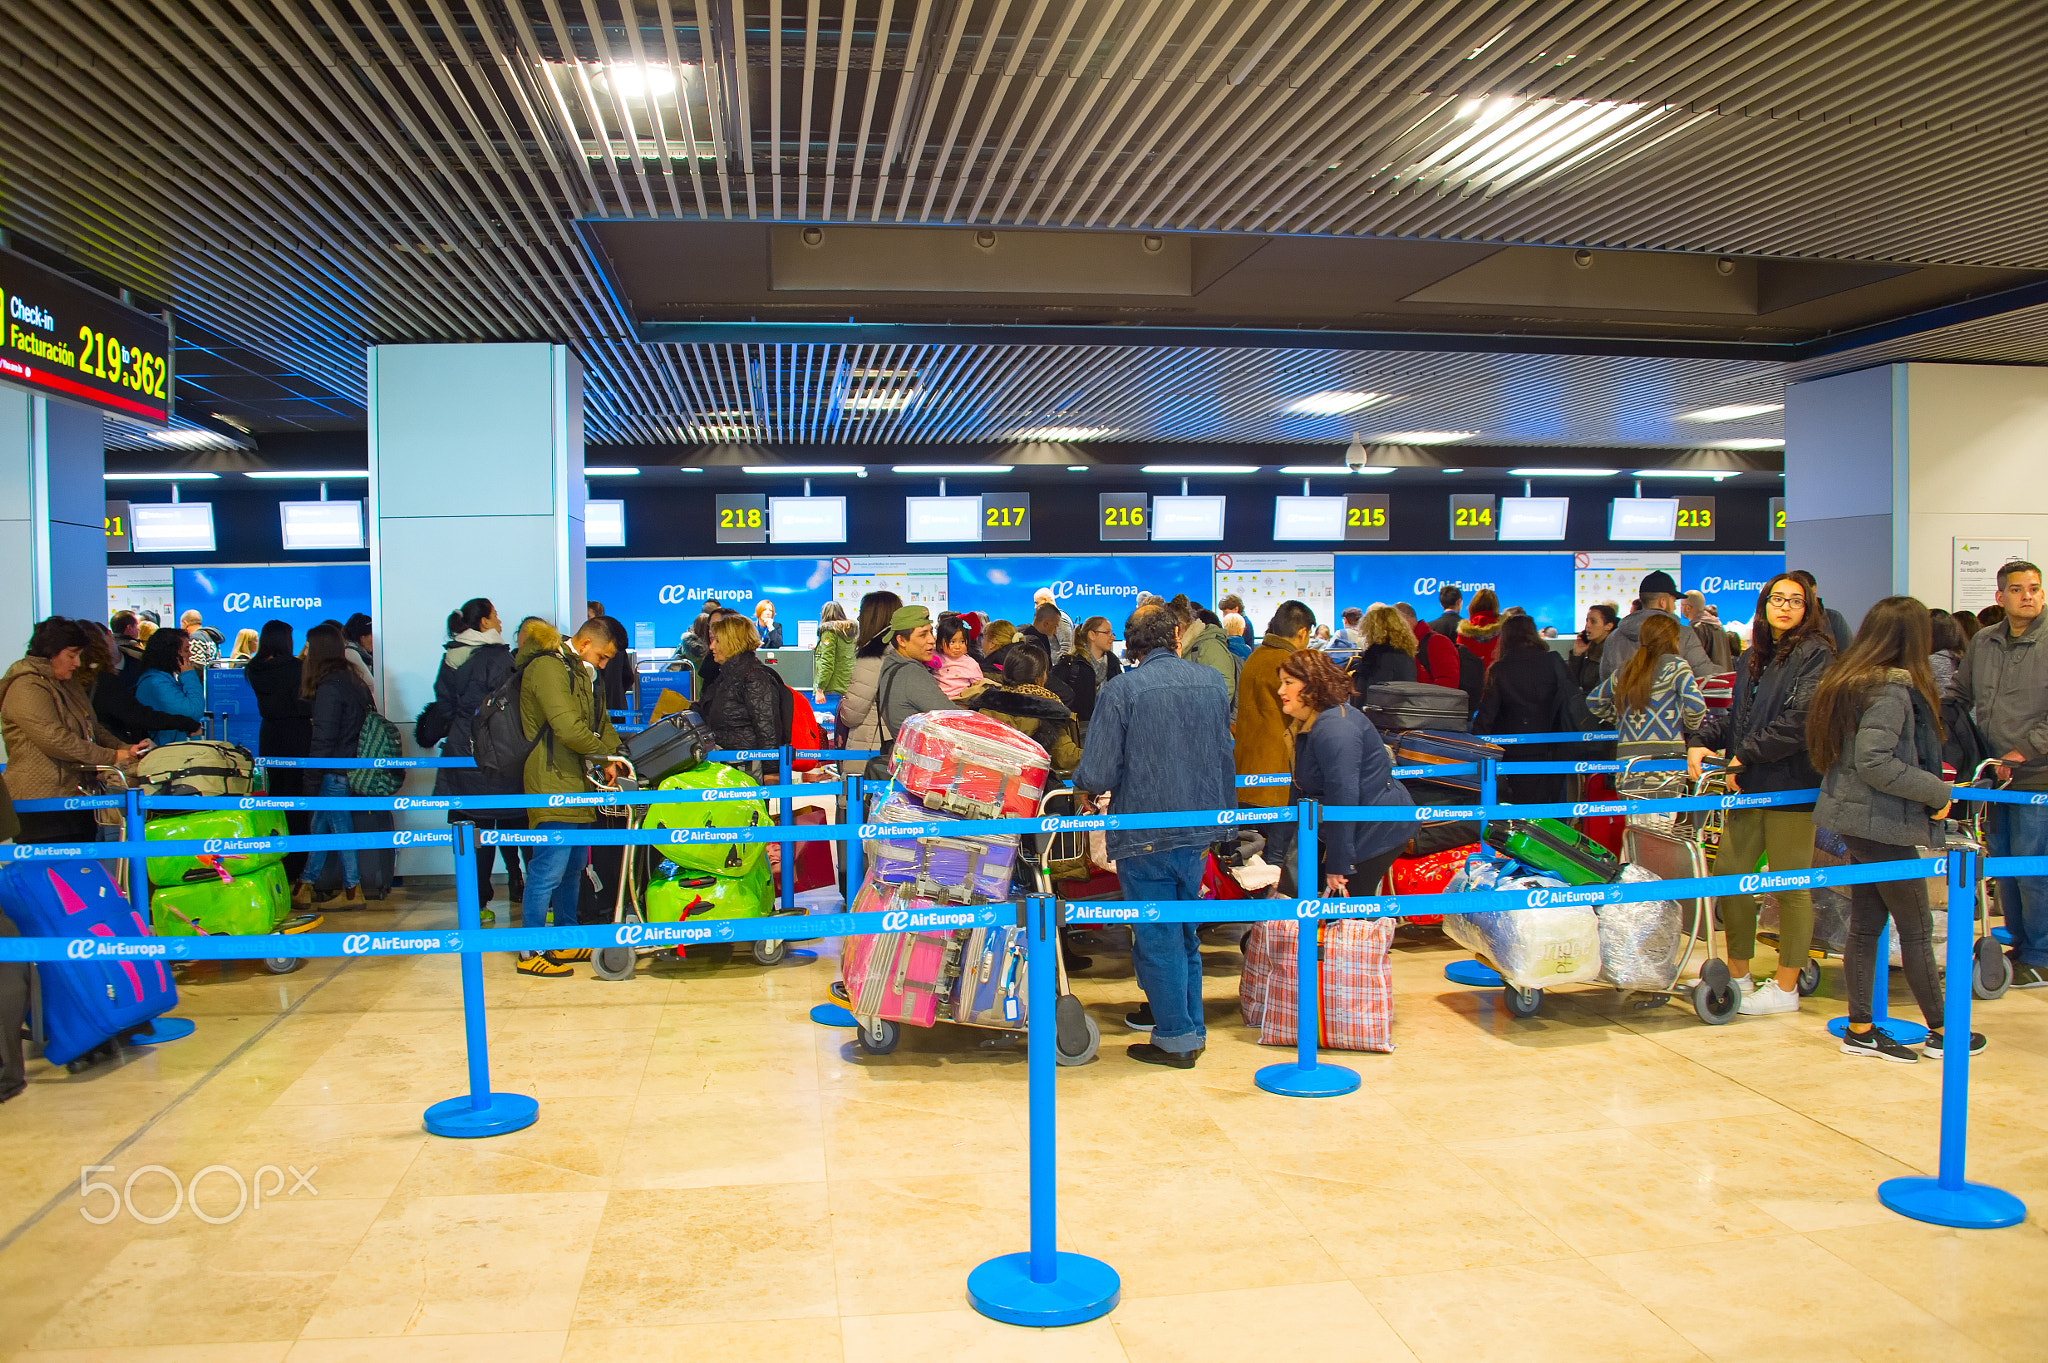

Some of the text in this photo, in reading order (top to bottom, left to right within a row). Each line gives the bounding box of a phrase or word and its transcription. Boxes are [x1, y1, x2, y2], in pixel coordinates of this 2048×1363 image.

[11, 295, 54, 331] Check-in
[11, 323, 166, 400] Facturación 219 to 362
[720, 508, 762, 528] 218
[986, 507, 1026, 527] 217
[1105, 507, 1144, 526] 216
[1348, 508, 1386, 527] 215
[1456, 507, 1492, 526] 214
[1677, 509, 1712, 527] 213
[686, 588, 753, 602] AirEuropa
[1076, 583, 1138, 600] AirEuropa
[252, 595, 322, 611] AirEuropa
[1588, 764, 1620, 772] AirEuropa
[564, 796, 604, 805] AirEuropa
[717, 790, 757, 799] AirEuropa
[1736, 796, 1772, 805] AirEuropa
[80, 799, 119, 807] AirEuropa
[255, 799, 295, 808] AirEuropa
[408, 799, 450, 808] AirEuropa
[1588, 804, 1628, 813] AirEuropa
[1235, 811, 1279, 821] AirEuropa
[1432, 809, 1473, 819] AirEuropa
[877, 825, 924, 836] AirEuropa
[1060, 819, 1105, 829] AirEuropa
[412, 832, 453, 842] AirEurop
[499, 833, 548, 843] AirEuropa
[690, 831, 738, 841] AirEuropa
[33, 846, 81, 857] AirEuropa
[223, 840, 271, 850] AirEuropa
[1760, 874, 1811, 888] AirEuropa
[1550, 891, 1605, 904] AirEuropa
[1075, 906, 1140, 921] AirEuropa
[1321, 902, 1381, 915] AirEuropa
[909, 913, 975, 928] AirEuropa
[643, 927, 711, 941] AirEuropa
[96, 942, 166, 957] AirEuropa
[371, 937, 441, 952] AirEuropa
